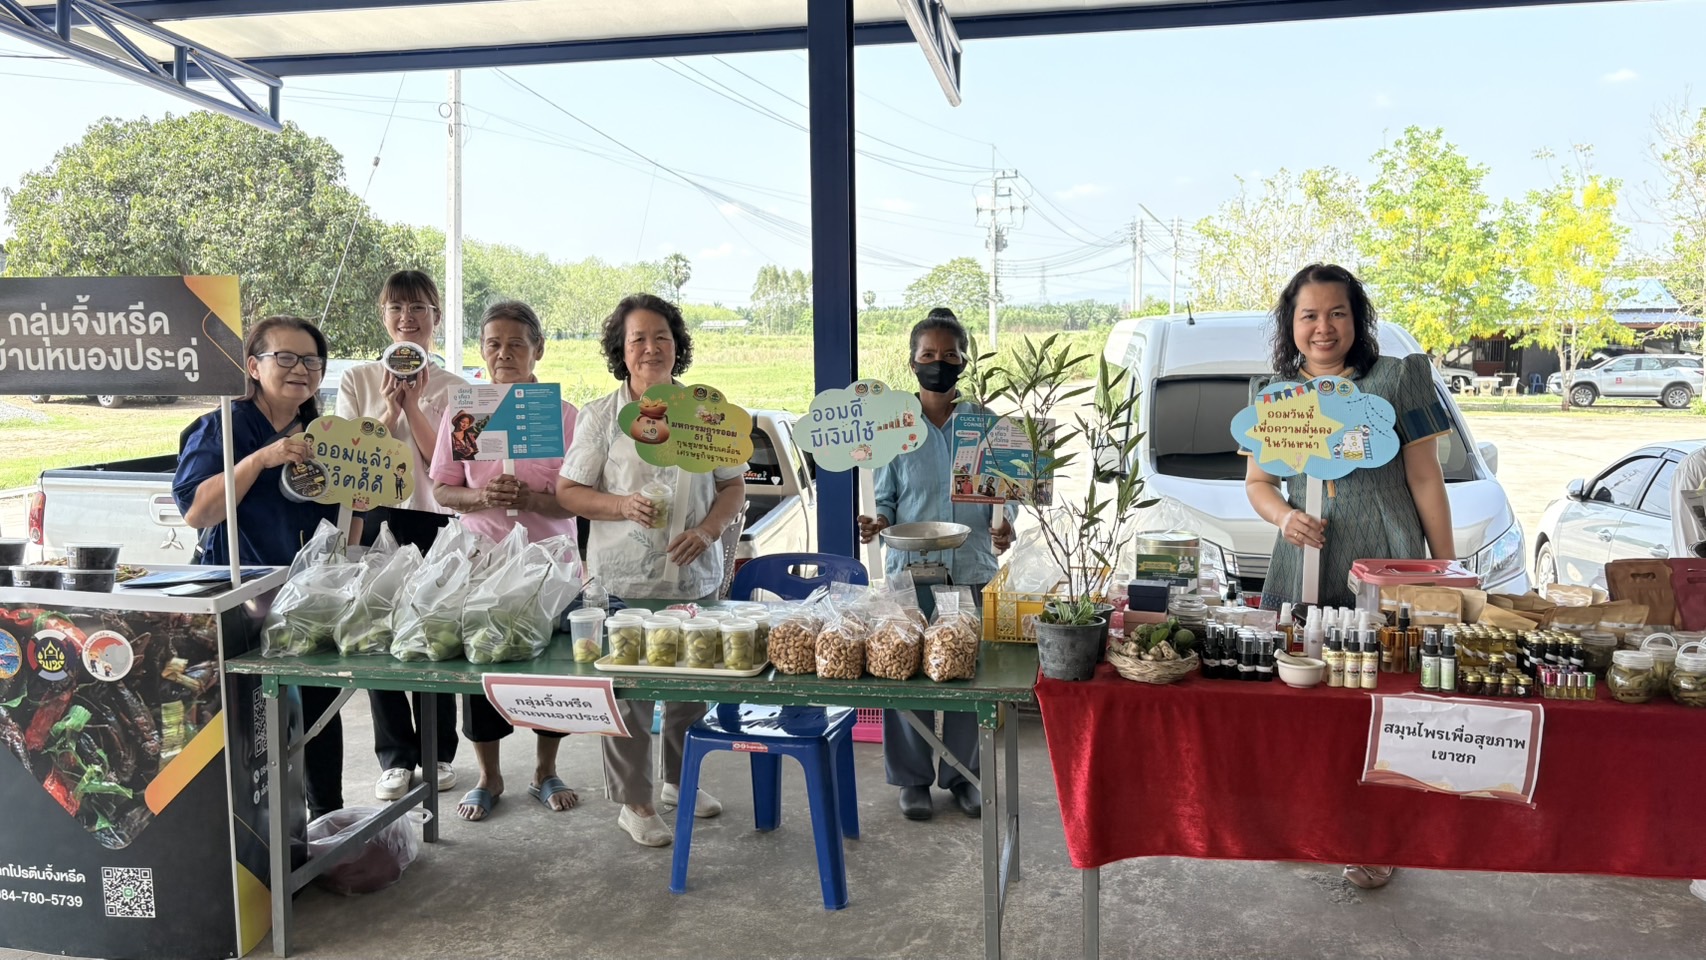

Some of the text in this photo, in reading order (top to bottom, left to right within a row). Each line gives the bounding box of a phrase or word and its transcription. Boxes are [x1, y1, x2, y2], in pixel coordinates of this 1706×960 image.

[8, 295, 170, 345] กลุ่มจิ้งหรีด
[812, 398, 863, 422] ออมดี
[1267, 405, 1315, 420] ออมวันนี้
[671, 422, 738, 437] มหกรรมการออม
[811, 420, 875, 447] มีเงินใช้
[1253, 420, 1332, 436] เพื่อความมั่นคง
[1264, 435, 1320, 449] ในวันหน้า
[317, 441, 391, 470] ออมแล้ว
[515, 694, 593, 709] กลุ่มจิ้งหรีด
[507, 706, 611, 724] บ้านหนองประดู่
[1384, 722, 1526, 750] สมุนไพรเพื่อสุขภาพ
[0, 888, 84, 908] 84-780-5739
